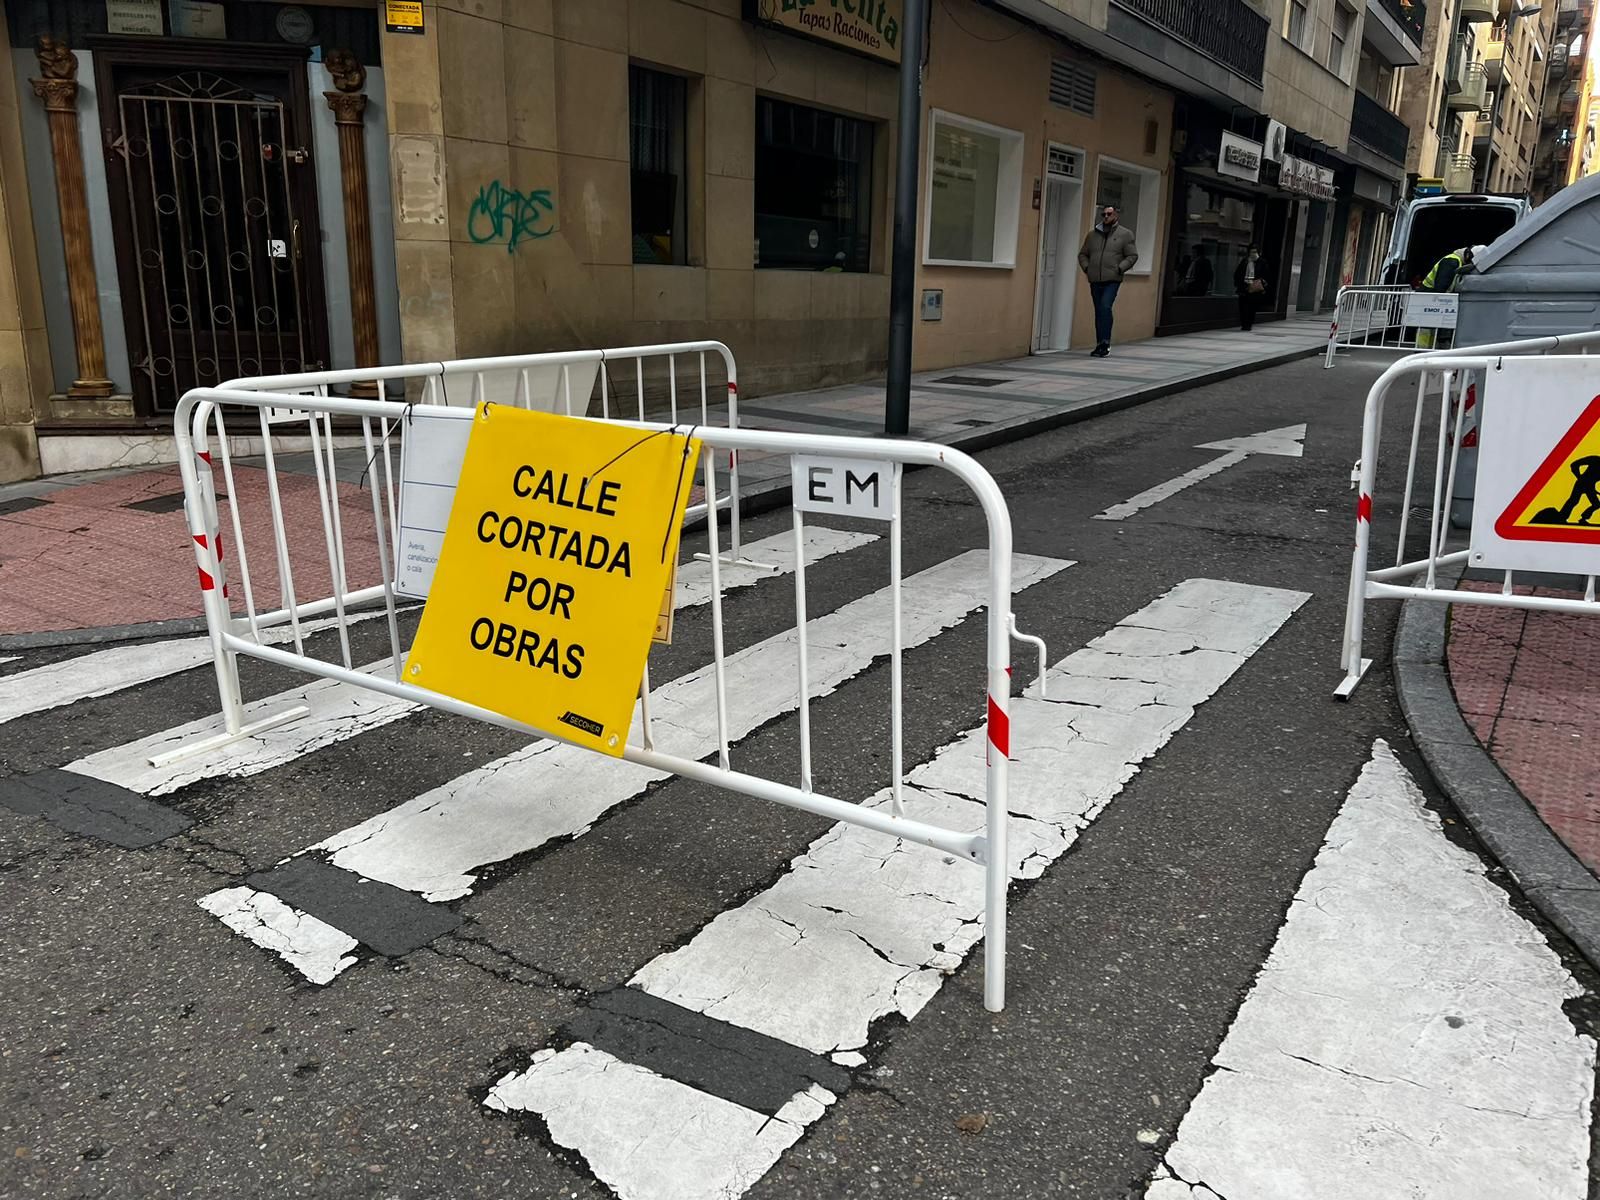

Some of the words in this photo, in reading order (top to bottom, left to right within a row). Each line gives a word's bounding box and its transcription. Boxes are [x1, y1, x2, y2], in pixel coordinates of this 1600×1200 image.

[799, 8, 831, 31] Tapas
[833, 12, 881, 49] Raciones
[513, 464, 622, 517] CALLE
[477, 510, 631, 578] CORTADA
[504, 570, 575, 620] POR
[470, 617, 585, 679] OBRAS
